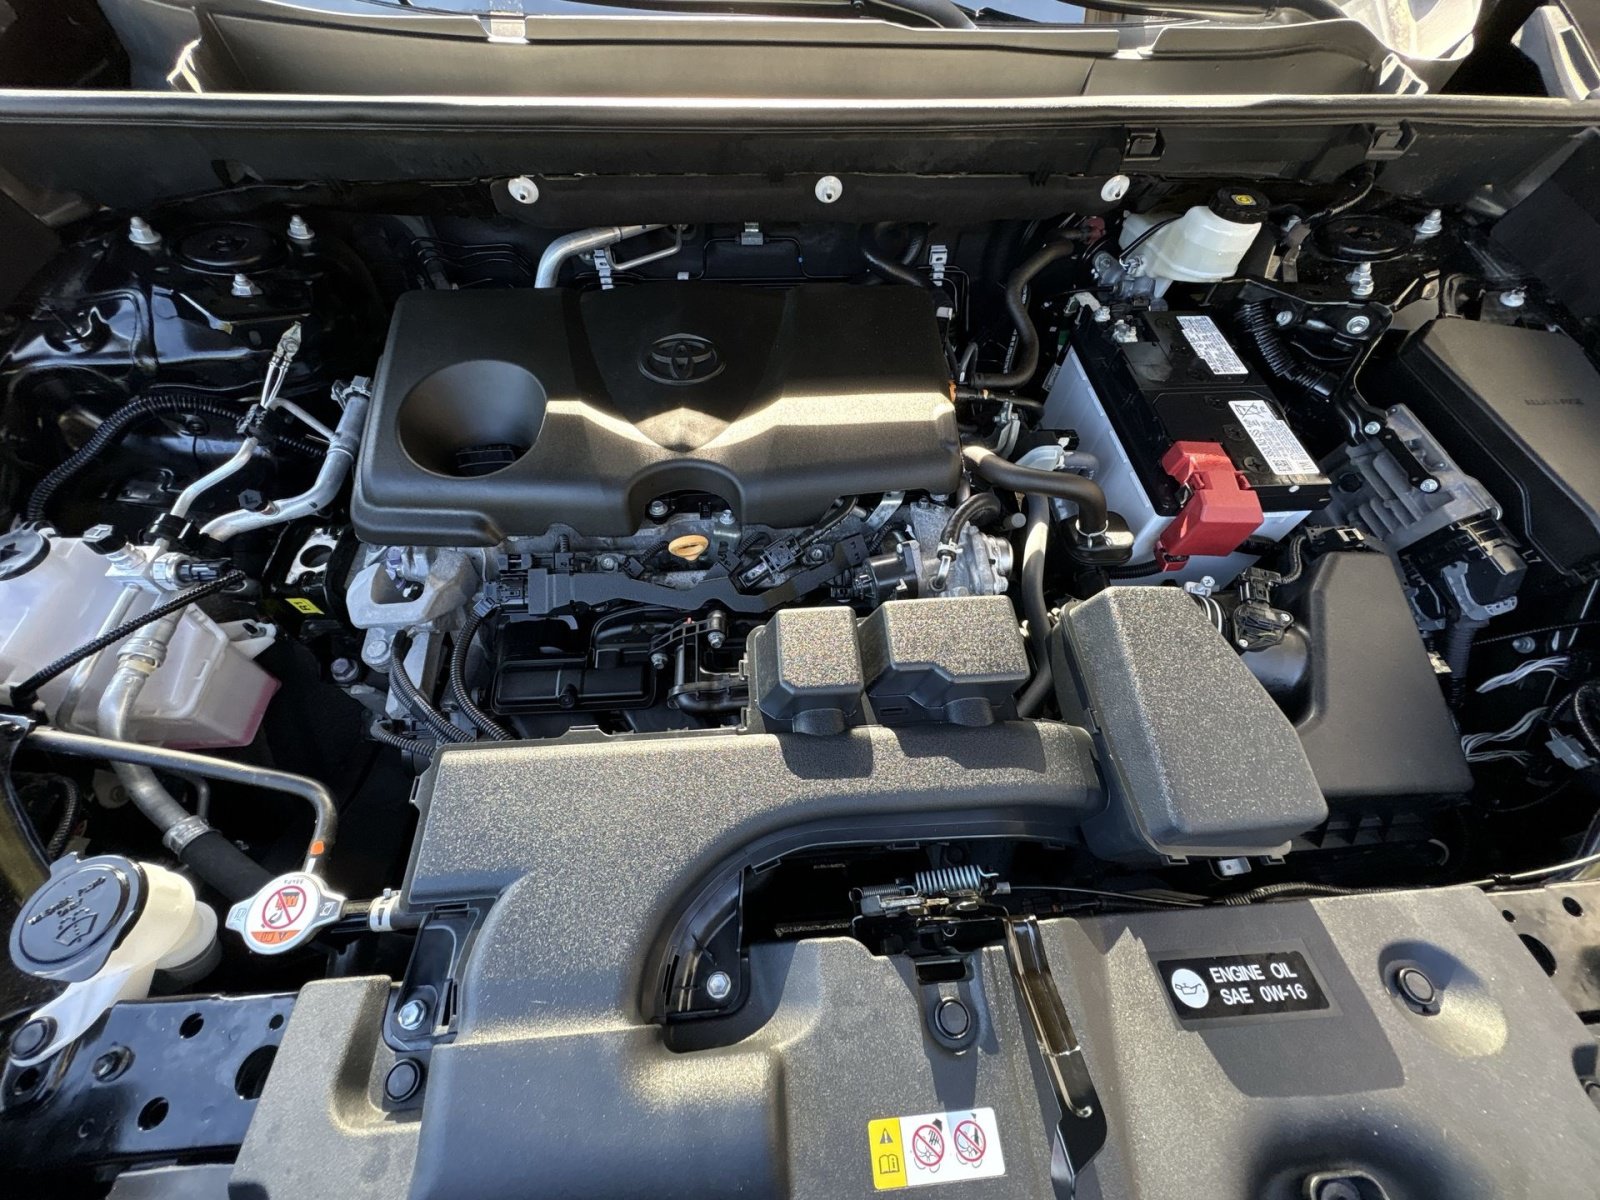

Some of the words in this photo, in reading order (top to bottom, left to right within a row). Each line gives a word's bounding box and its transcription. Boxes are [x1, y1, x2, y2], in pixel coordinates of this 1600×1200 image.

[1208, 964, 1266, 984] ENGINE
[1269, 962, 1298, 979] OIL
[1219, 986, 1255, 1006] SAE
[1259, 983, 1308, 1003] 0W-16
